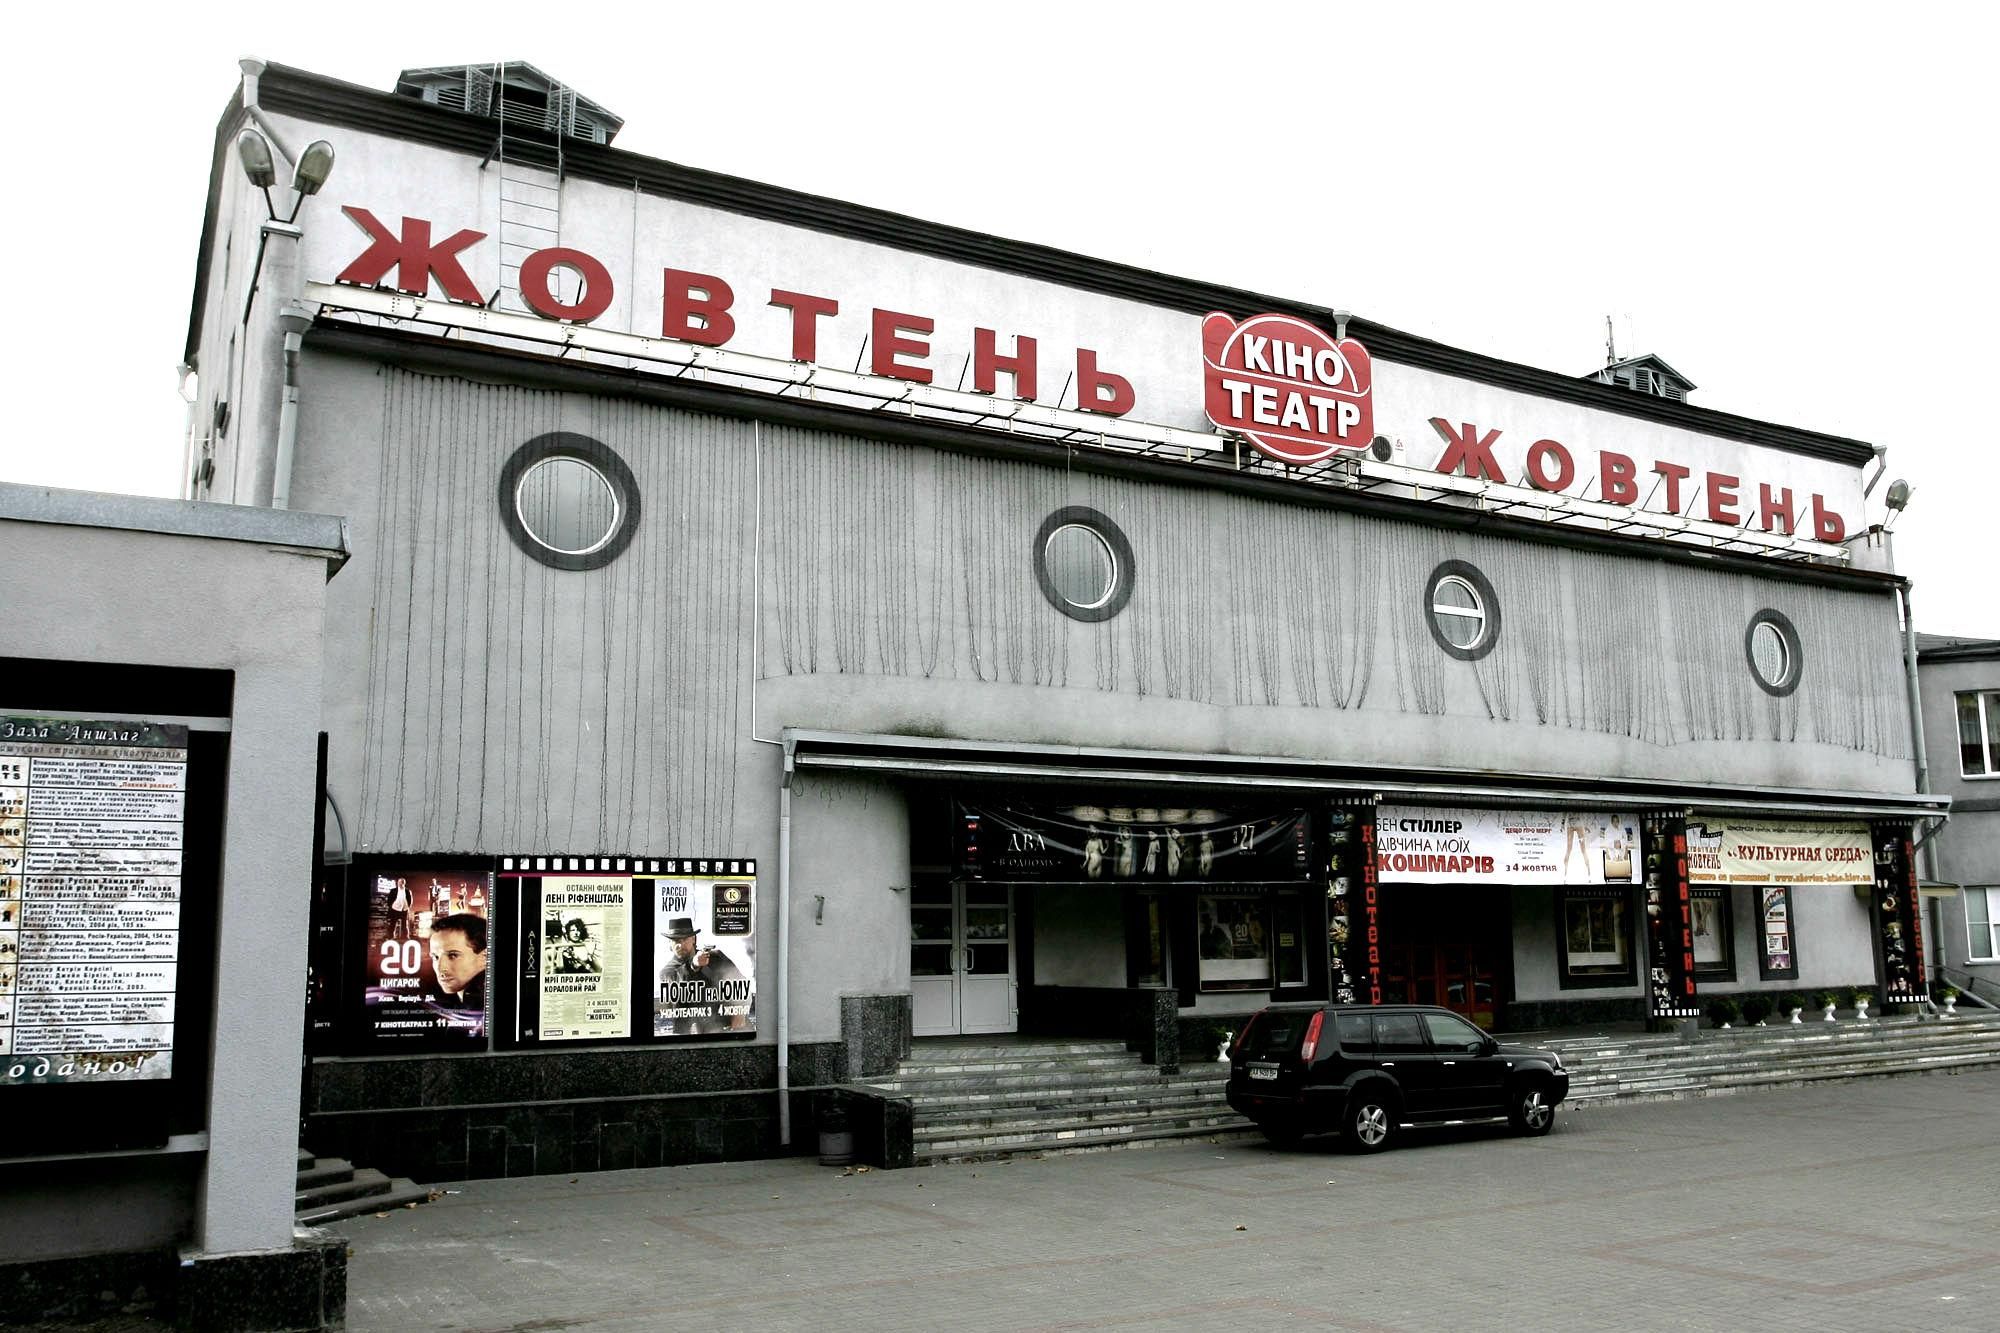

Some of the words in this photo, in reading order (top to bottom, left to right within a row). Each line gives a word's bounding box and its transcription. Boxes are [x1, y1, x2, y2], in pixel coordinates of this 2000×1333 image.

[336, 205, 1135, 418] ЖОВТЕНЬ
[1243, 333, 1344, 386] КІНО
[1222, 379, 1361, 438] ТЕАТР
[1428, 417, 1846, 543] ЖОВТЕНЬ
[4, 722, 49, 738] Зала
[1376, 818, 1397, 832] БЕН
[1399, 819, 1463, 833] СТІЛЛЕР
[1008, 833, 1046, 852] ДВА
[1240, 825, 1255, 850] 27
[1378, 837, 1432, 852] ДІВЧИНА
[1436, 837, 1470, 853] МОЇХ
[1377, 853, 1495, 873] КОШМАРІВ
[1513, 863, 1519, 871] 4
[566, 884, 595, 892] ОСТАННІ
[597, 884, 623, 892] ФІЛЬМИ
[661, 886, 687, 896] РАССЕЛ
[545, 893, 565, 903] ЛЕНІ
[568, 893, 624, 903] РІФЕНШТАЛЬ
[662, 897, 687, 912] КРОУ
[1674, 835, 1695, 995] ЖОВТЕНЬ
[380, 939, 421, 975] 20
[380, 978, 420, 989] ЦИГАРОК
[544, 975, 558, 984] МРІЇ
[575, 975, 602, 983] АФРИКУ
[544, 983, 583, 993] КОРАЛОВИЙ
[584, 983, 597, 992] РАЙ
[660, 981, 705, 1003] ПОТЯГ
[706, 988, 719, 1002] НА
[719, 979, 751, 1001] ЮМУ
[718, 1004, 723, 1016] 4
[381, 1020, 426, 1028] КІНОТЕАТРАХ
[436, 1018, 446, 1027] 11
